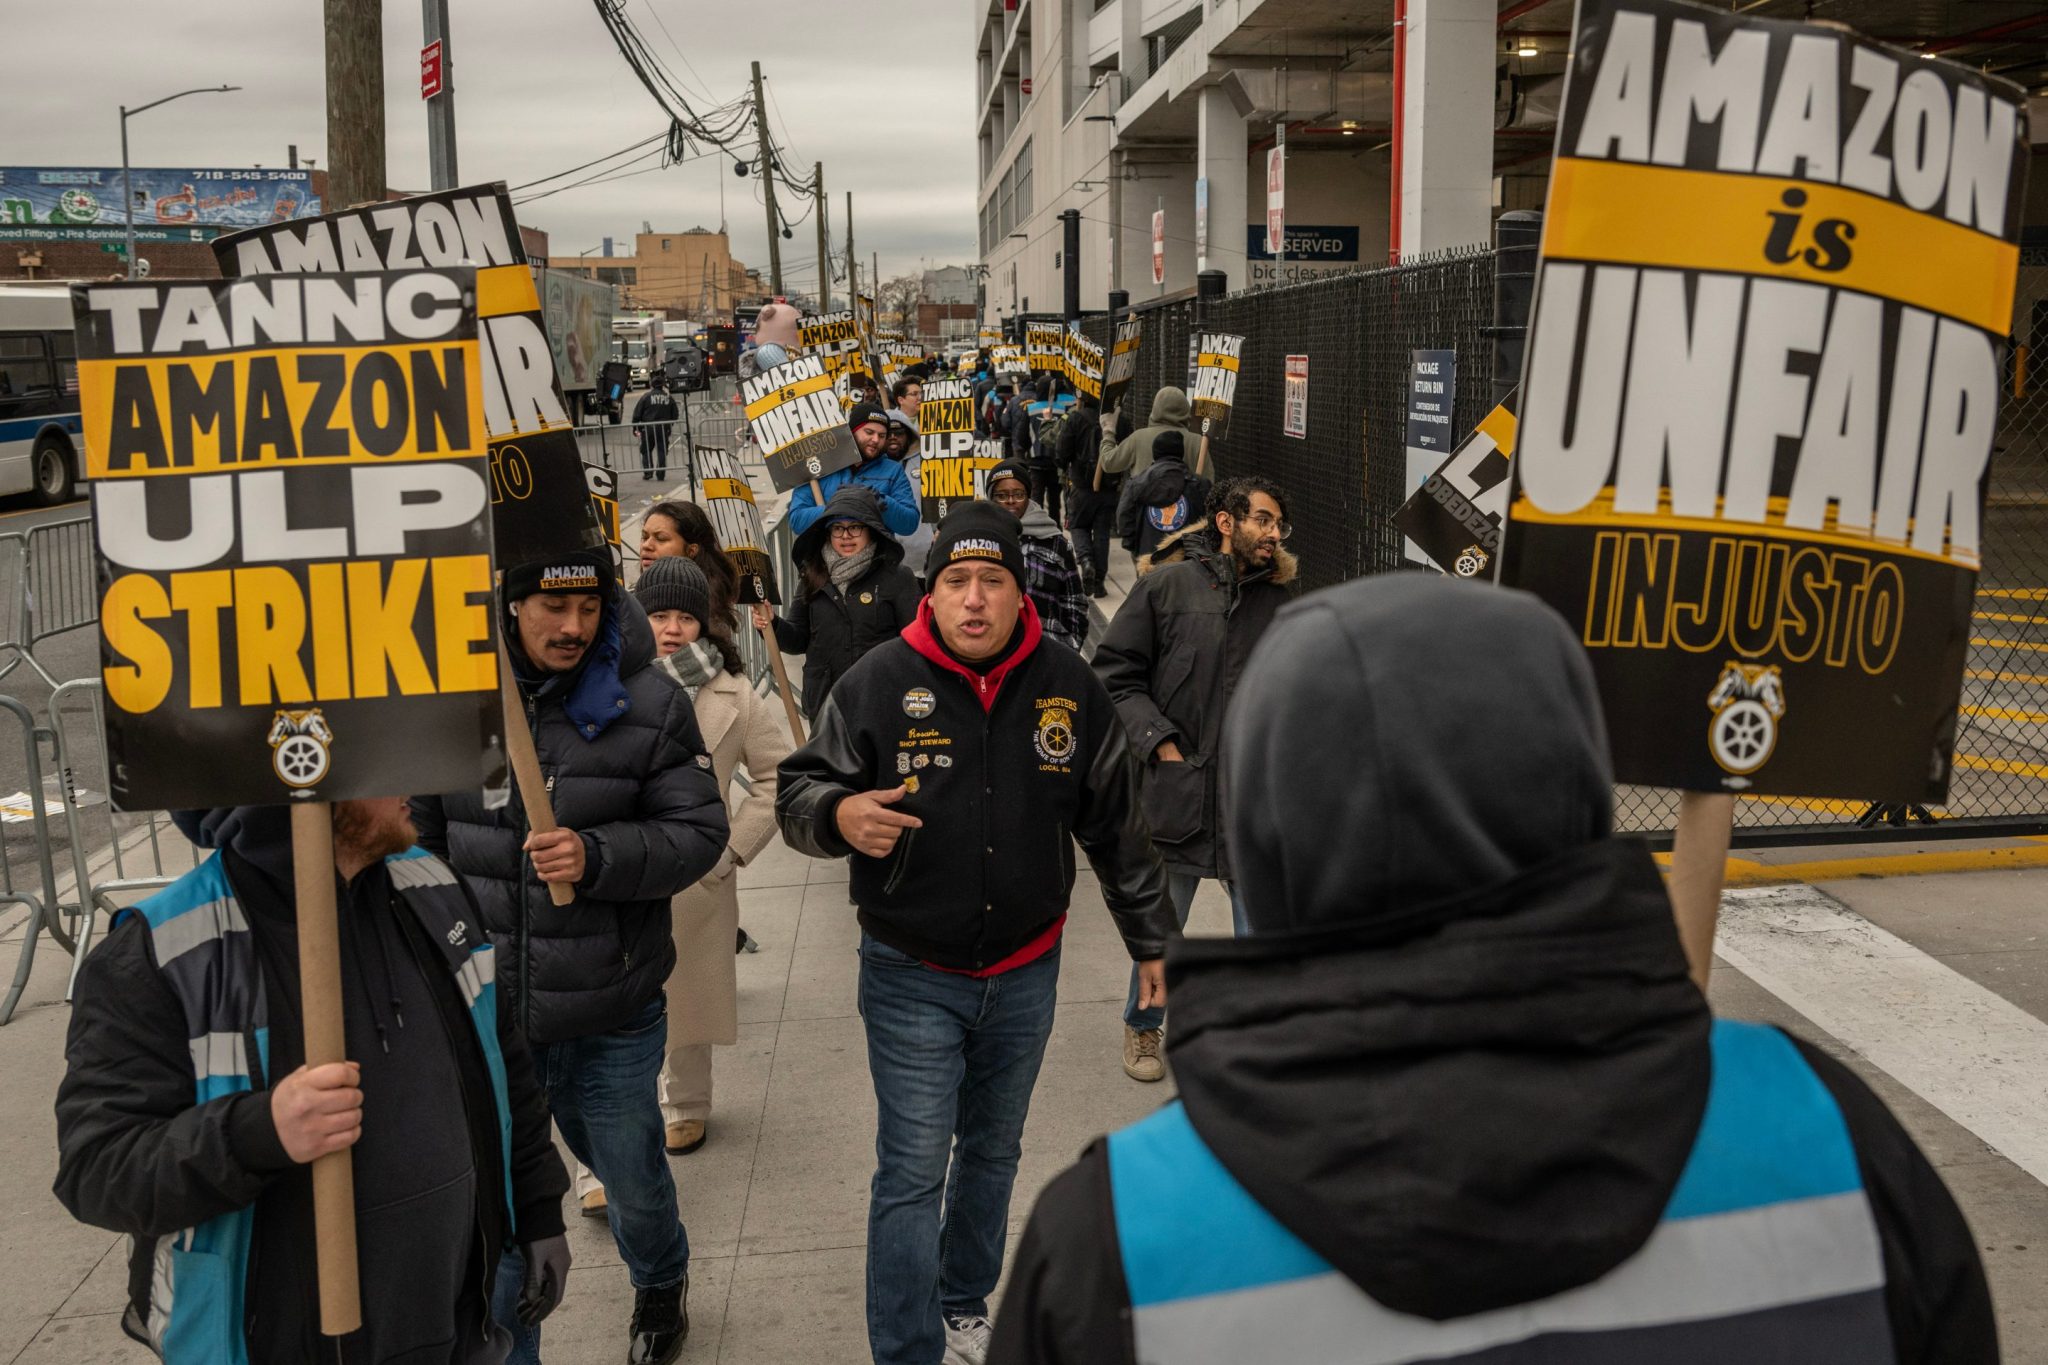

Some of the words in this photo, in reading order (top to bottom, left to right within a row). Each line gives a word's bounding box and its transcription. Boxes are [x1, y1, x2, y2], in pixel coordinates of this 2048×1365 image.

[1575, 10, 2015, 237] AMAZON
[193, 171, 306, 180] 718-545-5400
[24, 229, 57, 240] Fittings
[236, 196, 514, 277] AMAZON
[1763, 187, 1856, 272] is
[1263, 238, 1343, 252] SERVED
[1254, 264, 1318, 282] biccles
[88, 273, 462, 354] TANNC
[798, 310, 853, 328] TANNC
[803, 322, 856, 346] AMAZON
[1028, 324, 1060, 334] TANNC
[1029, 332, 1061, 345] AMAZON
[1068, 328, 1104, 356] TANNC
[802, 339, 860, 358] ULP
[992, 347, 1021, 358] OBEY
[1028, 344, 1062, 355] ULP
[1066, 336, 1102, 371] AMAZON
[994, 360, 1027, 374] LAW
[1029, 355, 1064, 371] STRIKE
[1064, 349, 1103, 379] ULP
[1213, 354, 1223, 366] is
[1417, 362, 1439, 375] PACKAGE
[742, 355, 824, 405] AMAZON
[1063, 361, 1101, 400] STRIKE
[1415, 380, 1432, 393] RETURN
[1432, 382, 1443, 394] BIN
[778, 387, 796, 401] is
[922, 378, 971, 402] TANNC
[107, 347, 471, 470] AMAZON
[921, 399, 972, 433] AMAZON
[1519, 263, 1998, 564] UNFAIR
[751, 389, 847, 456] UNFAIR
[779, 431, 837, 469] INJUSTO
[920, 432, 974, 460] ULP
[921, 457, 974, 498] STRIKE
[729, 480, 741, 496] is
[95, 462, 487, 571] ULP
[951, 548, 1001, 559] TEAMSTERS
[953, 539, 1000, 553] AMAZON
[543, 565, 596, 579] AMAZON
[541, 577, 598, 588] TEAMSTERS
[1584, 531, 1905, 675] INJUSTO
[101, 554, 498, 714] STRIKE
[1035, 697, 1077, 711] TEAMSTERS
[908, 728, 939, 738] Rosario
[899, 740, 917, 748] SHOP
[919, 738, 952, 746] STEWARD
[1039, 764, 1060, 772] LOCAL
